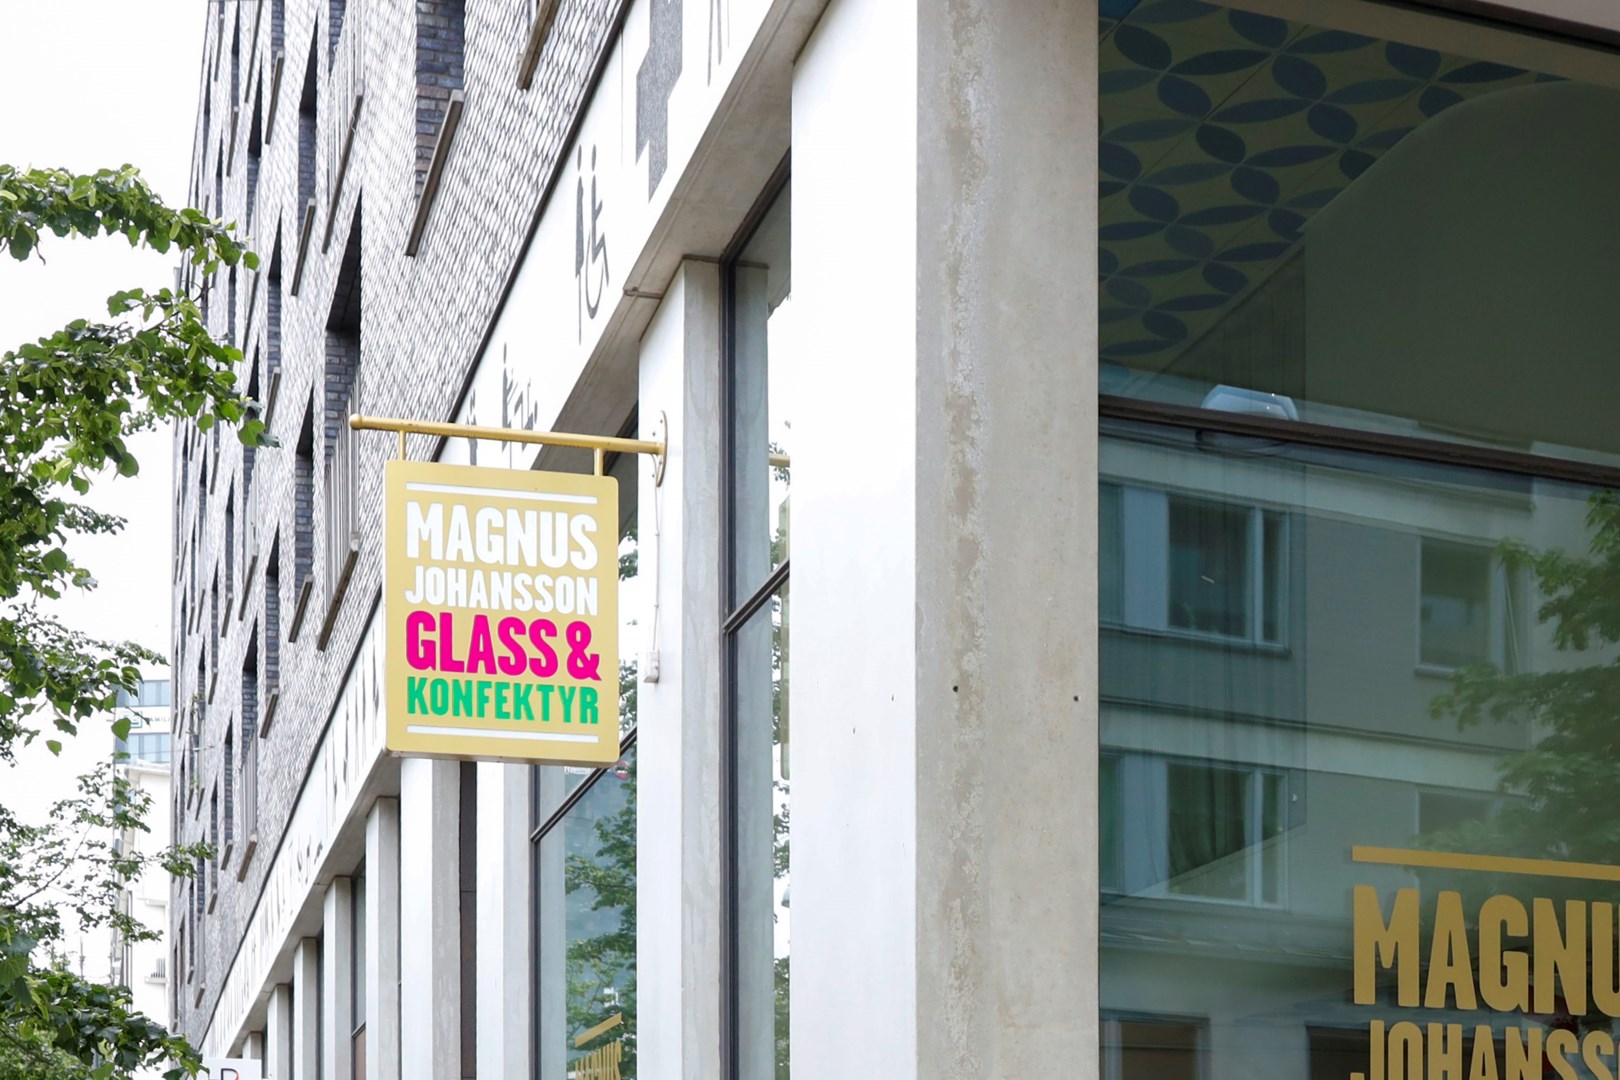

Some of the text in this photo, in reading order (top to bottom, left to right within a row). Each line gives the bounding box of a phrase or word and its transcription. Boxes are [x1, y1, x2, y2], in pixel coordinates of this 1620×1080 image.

[406, 501, 598, 570] MAGNUS
[405, 565, 598, 616] JOHANSSON
[405, 610, 559, 678] GLASS
[406, 676, 599, 724] KONFEKTYR
